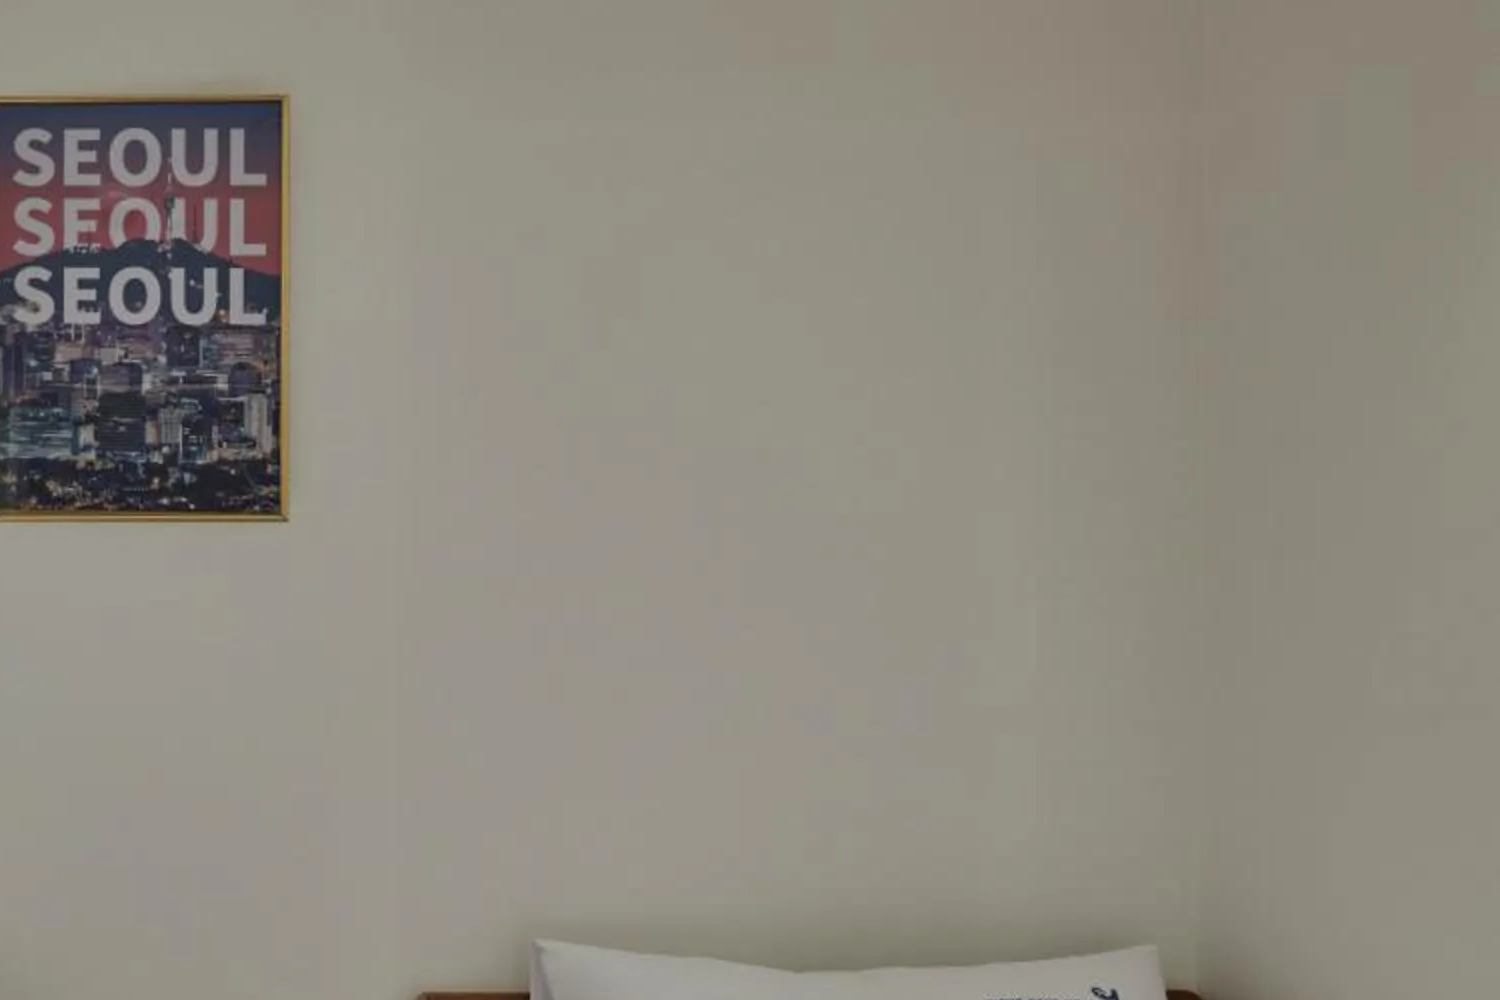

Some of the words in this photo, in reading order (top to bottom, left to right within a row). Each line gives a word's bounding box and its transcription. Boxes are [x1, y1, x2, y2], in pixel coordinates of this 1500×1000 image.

[12, 127, 267, 187] SEOUL
[12, 197, 267, 256] SEOUL
[12, 266, 267, 326] SEOUL
